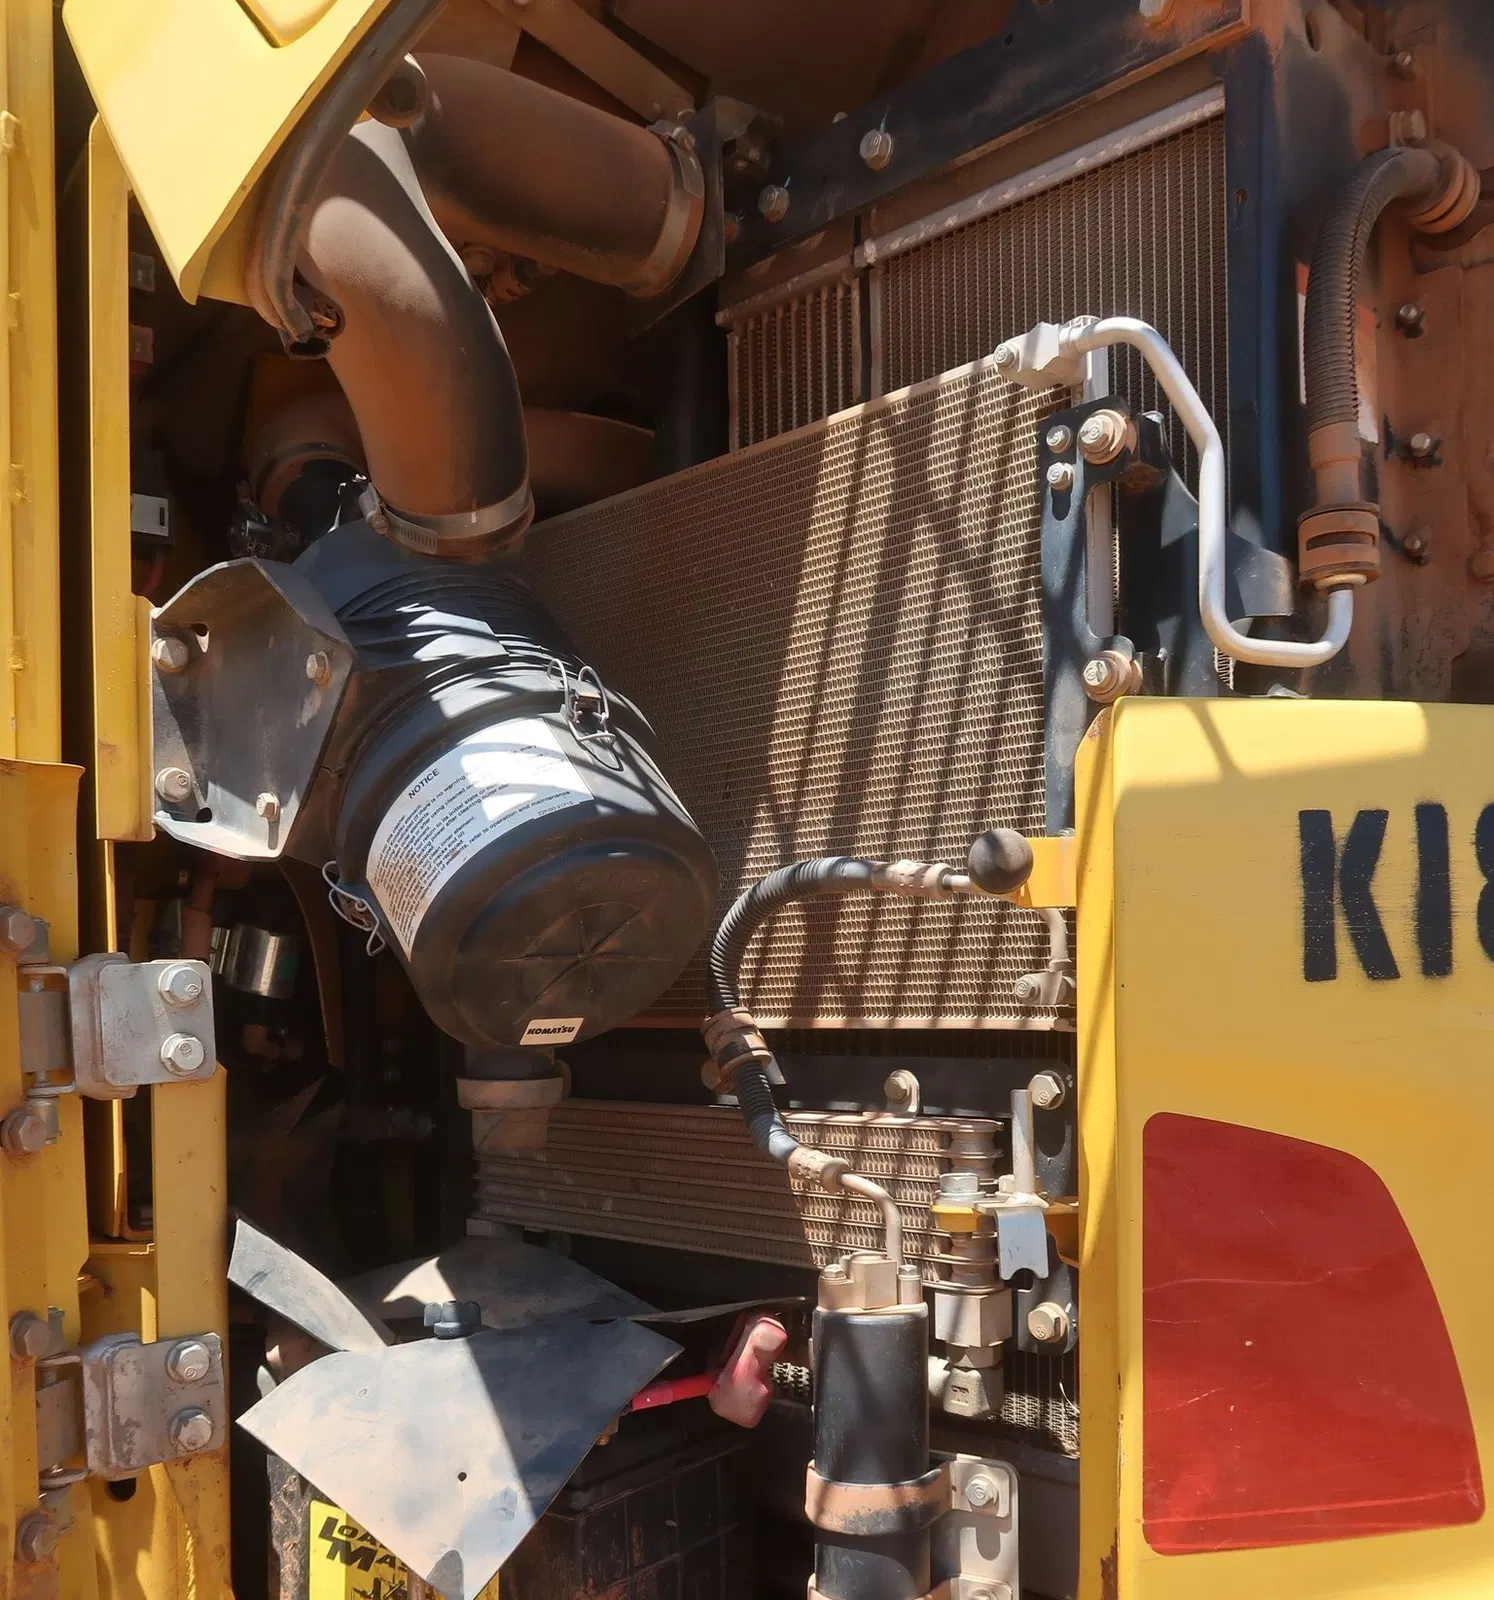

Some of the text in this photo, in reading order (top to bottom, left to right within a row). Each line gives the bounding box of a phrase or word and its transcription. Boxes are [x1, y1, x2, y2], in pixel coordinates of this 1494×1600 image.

[408, 767, 441, 799] NOTICE
[417, 801, 431, 815] there
[435, 790, 443, 798] no
[443, 774, 465, 792] warning
[415, 842, 423, 851] not
[422, 827, 436, 842] return
[448, 802, 463, 815] initial
[463, 792, 478, 804] state
[419, 817, 430, 829] after
[430, 804, 444, 818] using
[444, 787, 464, 805] cleaned
[430, 825, 445, 841] power
[445, 814, 457, 826] after
[457, 798, 481, 816] cleaning
[481, 788, 497, 799] outer
[468, 831, 481, 843] refer
[488, 810, 517, 828] operation
[517, 803, 530, 812] and
[530, 790, 570, 806] maintenance
[428, 845, 441, 859] clean
[440, 833, 453, 846] inner
[432, 847, 447, 863] cracks
[447, 837, 457, 848] and
[527, 1025, 576, 1035] KOMATSU
[318, 1516, 387, 1547] LOA
[326, 1540, 408, 1573] MA
